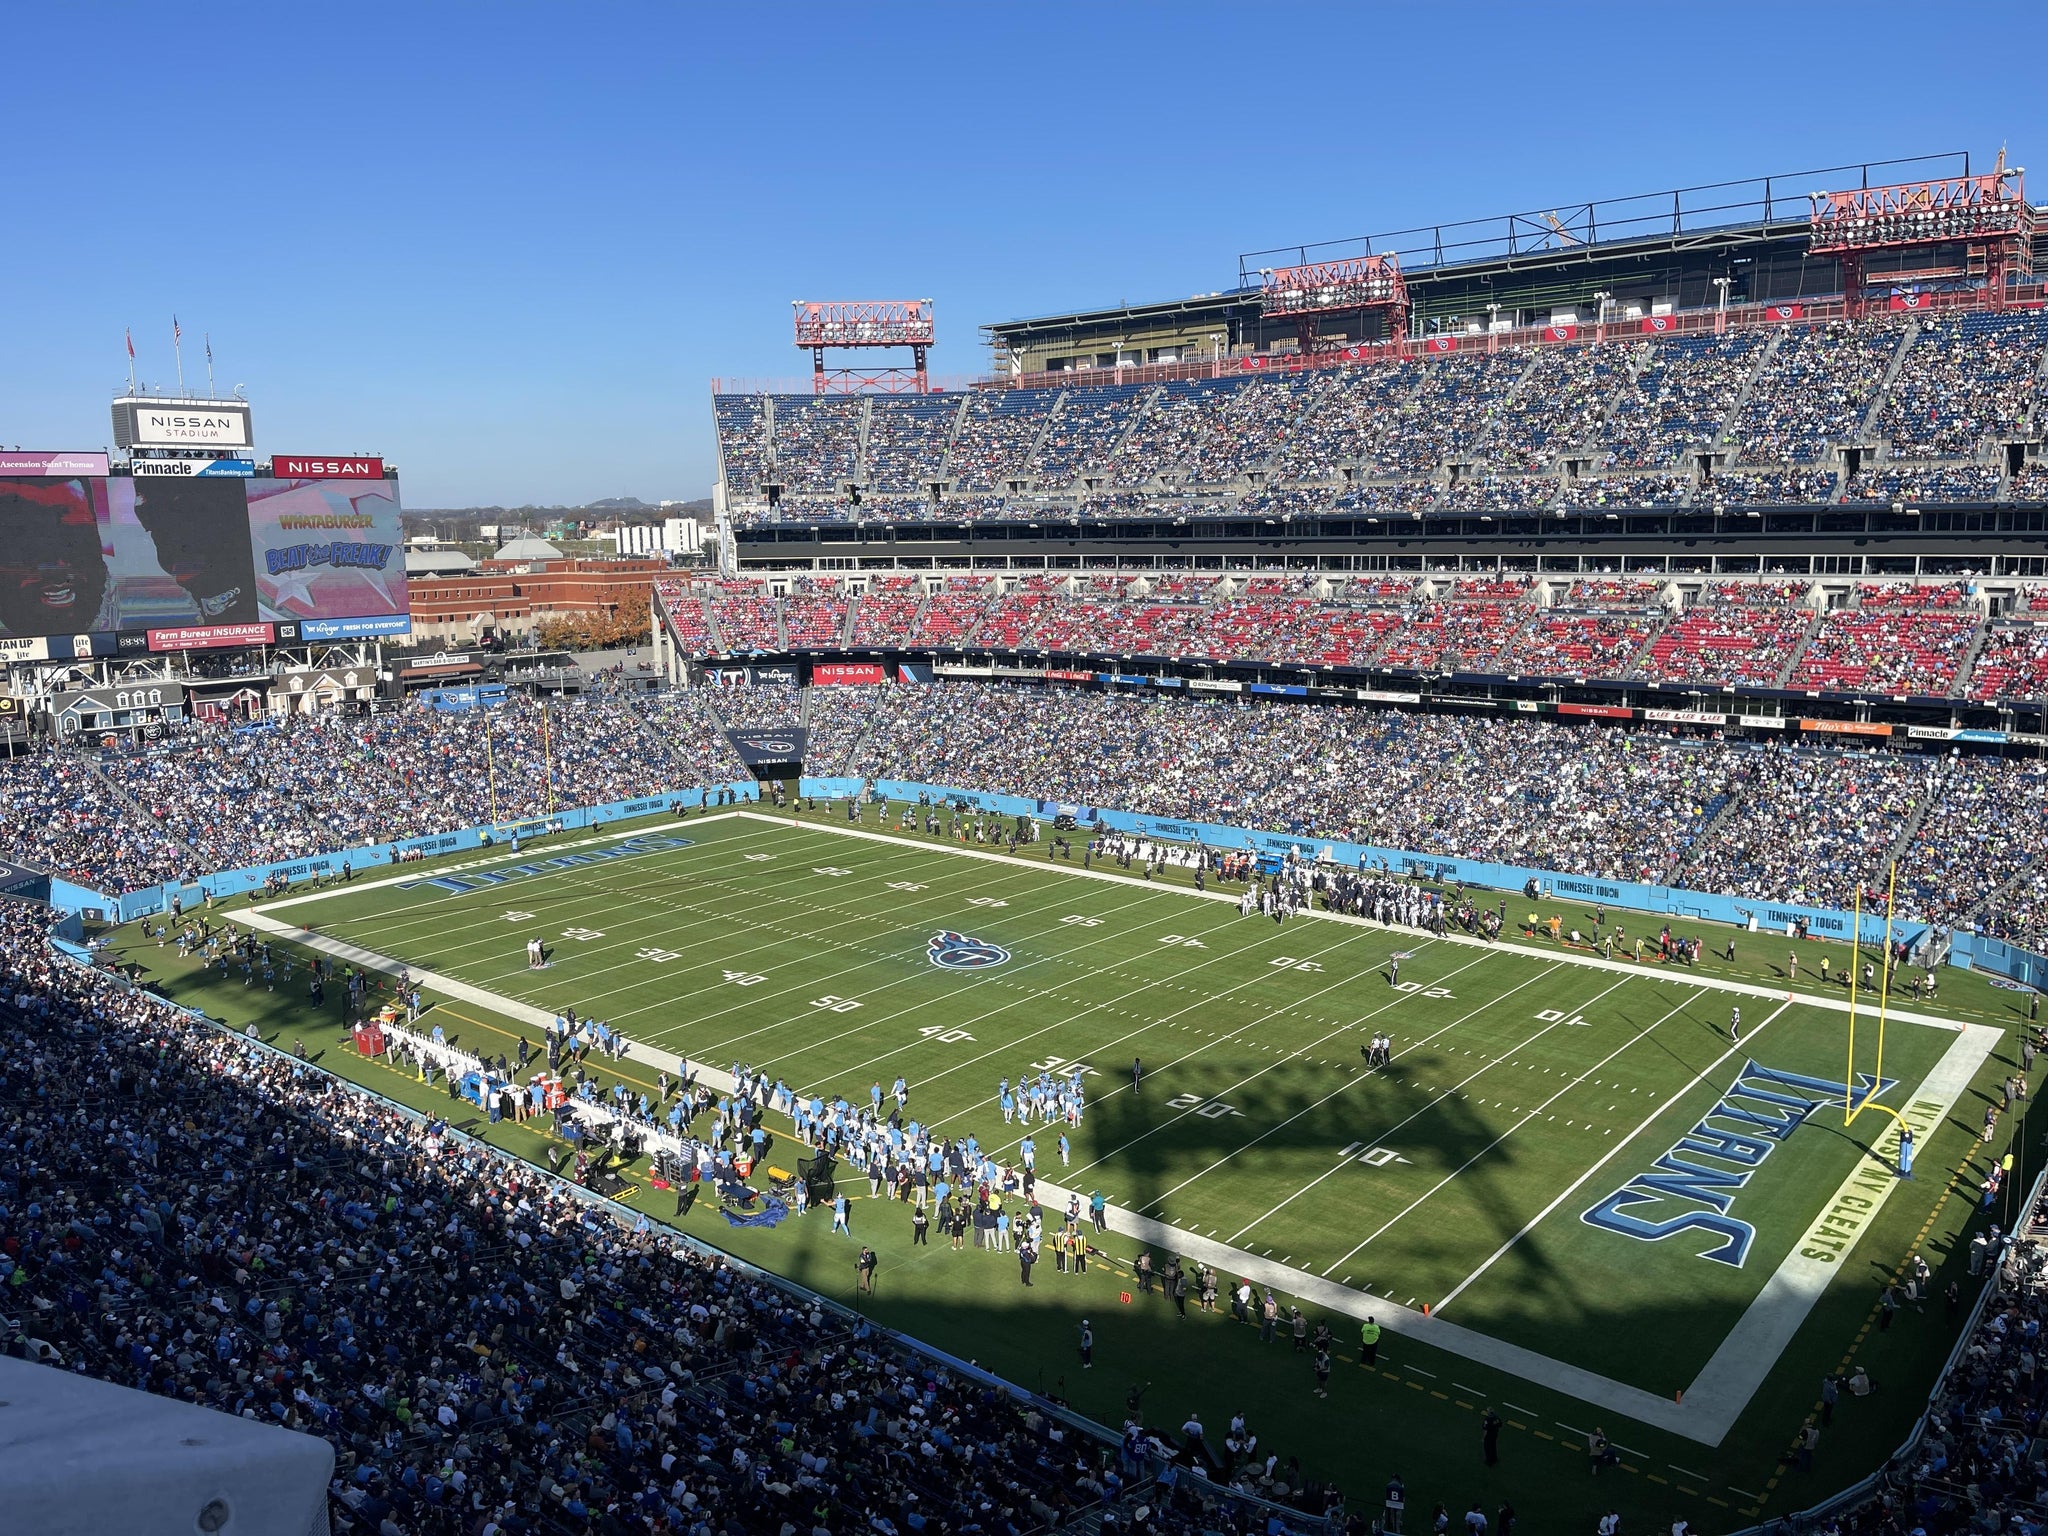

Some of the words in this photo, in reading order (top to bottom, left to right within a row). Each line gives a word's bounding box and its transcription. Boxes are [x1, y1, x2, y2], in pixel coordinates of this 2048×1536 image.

[152, 416, 230, 428] NISSAN
[166, 429, 218, 438] STADIUM
[133, 461, 191, 475] Pinnacle
[288, 462, 369, 474] NISSAN
[279, 514, 374, 530] WHATABURGER
[265, 544, 309, 576] BEAT
[308, 543, 330, 566] the
[330, 541, 393, 571] FREAK!
[156, 632, 178, 640] Farm
[180, 630, 211, 639] Bureau
[214, 626, 266, 637] INSURANCE
[316, 622, 340, 636] Kroger
[343, 624, 360, 632] FRESH
[20, 640, 34, 649] UP
[75, 638, 89, 648] Lite
[16, 651, 30, 659] Lite
[768, 668, 793, 682] Kroger
[1814, 722, 1841, 732] Tito's
[1910, 727, 1948, 738] Pinnacle
[624, 802, 648, 814] TENNESSEE
[649, 800, 664, 810] TOUGH
[1156, 822, 1181, 835] TENNESSEE
[439, 836, 456, 847] TOUGH
[394, 833, 695, 896] TITANS
[4, 878, 36, 894] NISSAN
[1557, 880, 1594, 895] TENNESSEE
[1596, 886, 1620, 898] TOUGH
[1059, 914, 1105, 928] 50
[1815, 917, 1844, 932] TOUGH
[561, 927, 605, 942] 20
[1157, 934, 1203, 948] 40
[634, 946, 682, 964] 30
[1268, 956, 1322, 972] 30
[722, 970, 768, 986] 40
[1395, 981, 1452, 998] 20
[810, 995, 864, 1013] 50
[1534, 1008, 1584, 1026] 10
[918, 1025, 969, 1043] 40
[1166, 1092, 1234, 1119] 20
[1907, 1099, 1945, 1121] MY
[1338, 1141, 1398, 1168] 10
[1580, 1058, 1900, 1269] TITANS
[1852, 1167, 1894, 1194] MY
[1800, 1194, 1875, 1264] CLEATS
[1120, 1292, 1130, 1304] 10
[1134, 1444, 1147, 1454] 80
[1391, 1490, 1399, 1500] B
